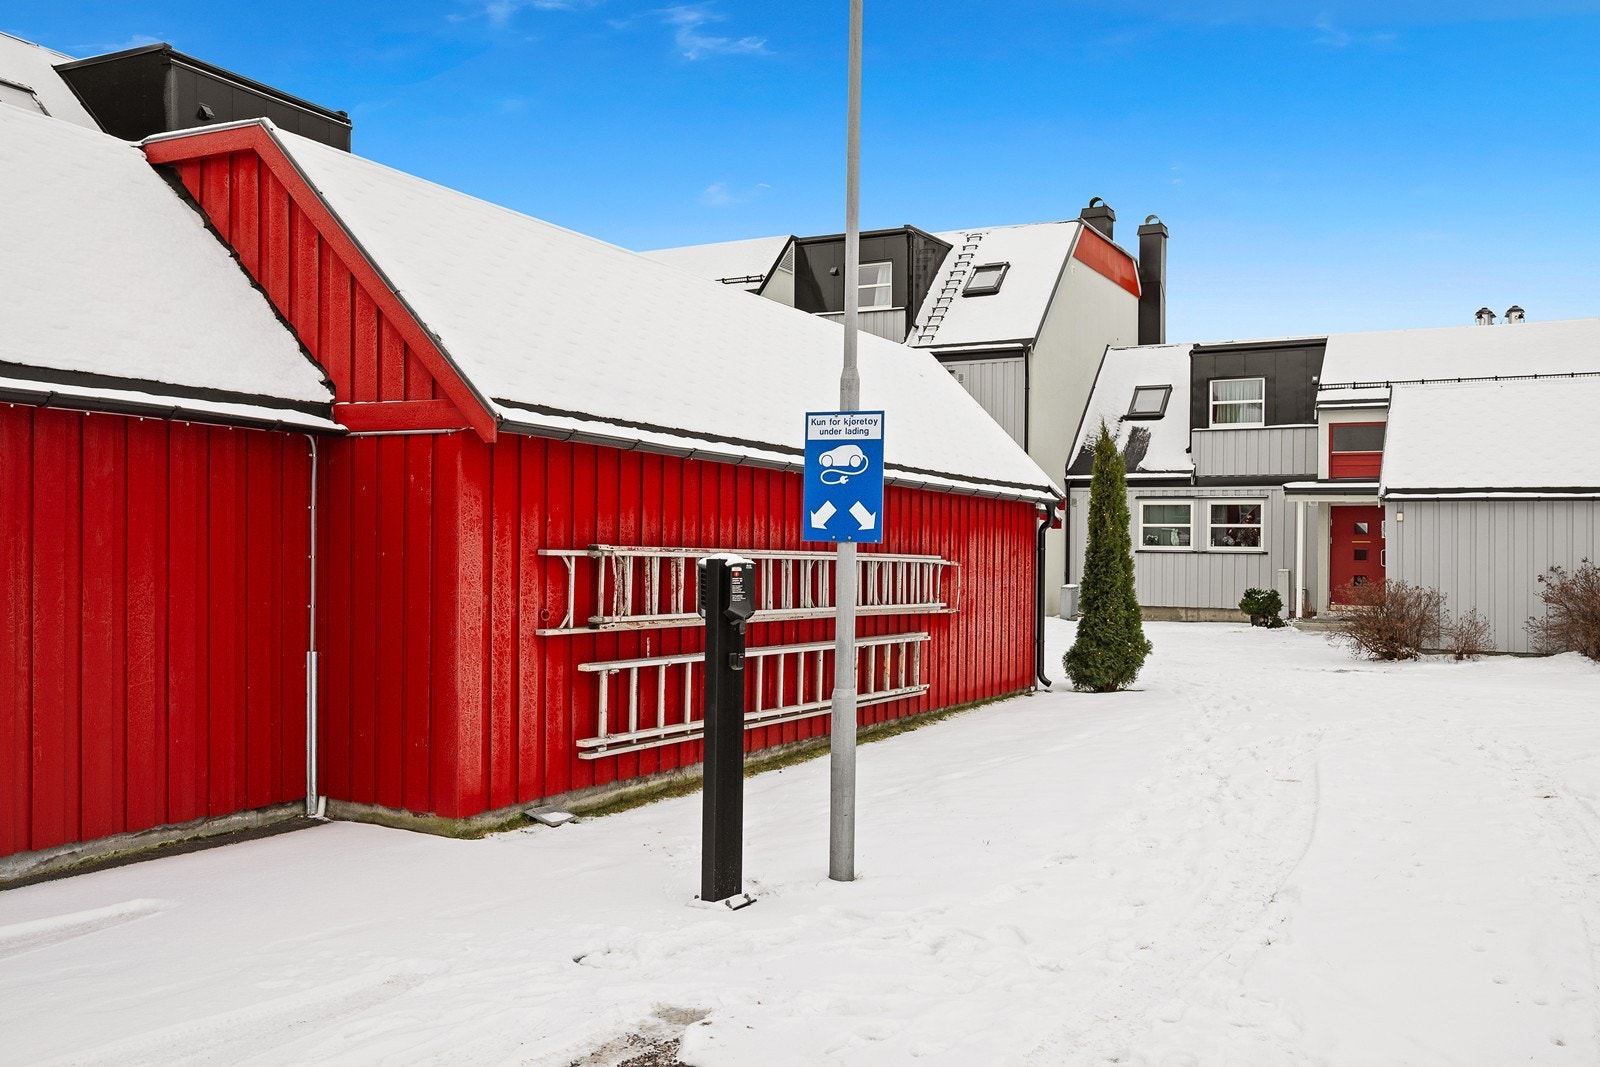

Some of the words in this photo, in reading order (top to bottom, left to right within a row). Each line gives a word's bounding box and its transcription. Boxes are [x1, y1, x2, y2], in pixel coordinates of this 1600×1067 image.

[811, 418, 826, 426] Kun
[829, 418, 841, 426] for
[845, 427, 869, 436] lading
